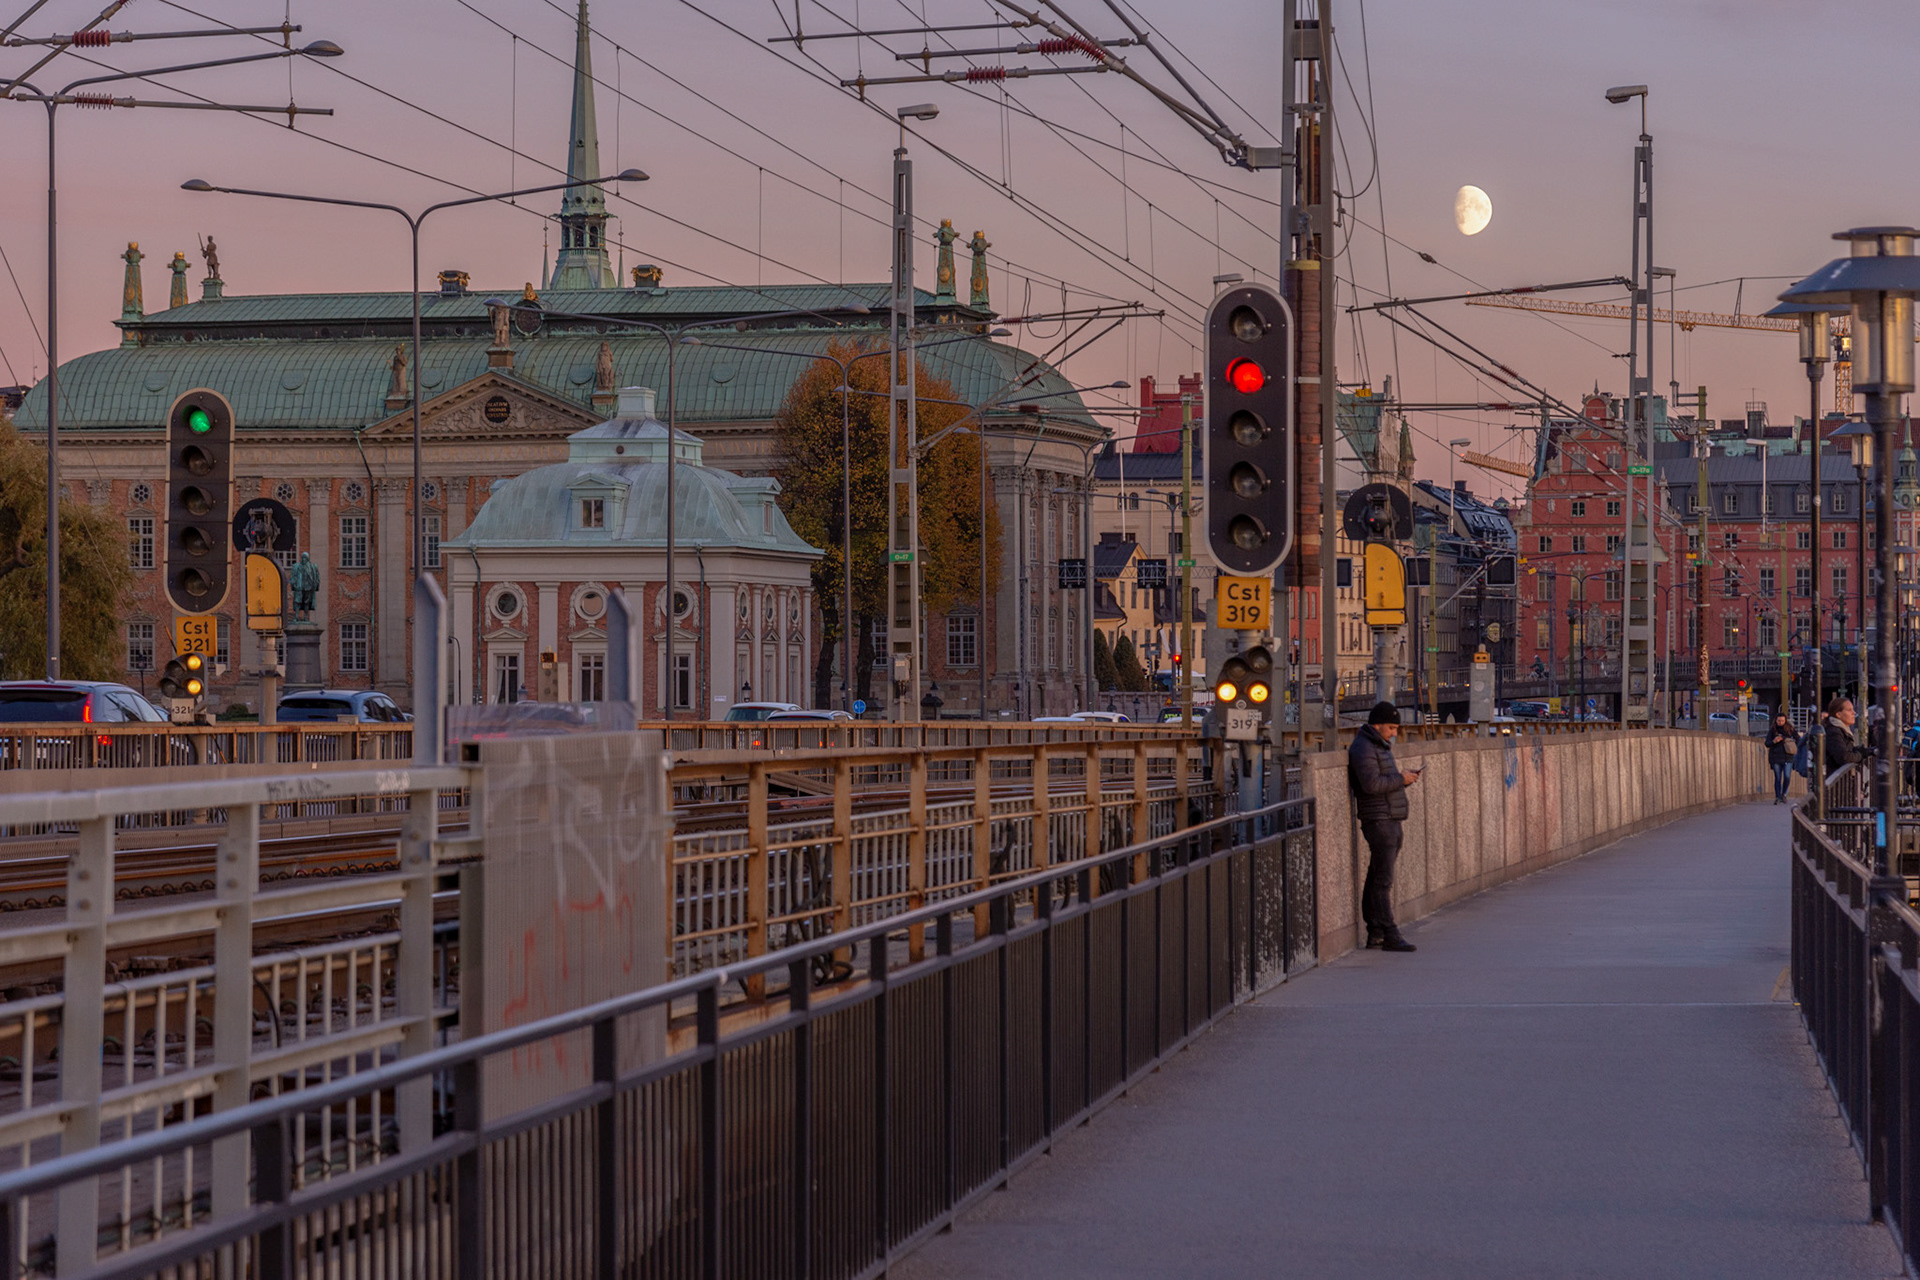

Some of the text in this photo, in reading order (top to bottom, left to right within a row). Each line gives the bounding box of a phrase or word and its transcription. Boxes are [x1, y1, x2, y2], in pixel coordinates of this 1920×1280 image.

[1228, 583, 1260, 601] Cst
[1226, 605, 1260, 623] 319
[183, 621, 209, 635] Cst
[183, 638, 210, 652] 321
[174, 706, 190, 714] 321
[1231, 719, 1253, 729] 319
